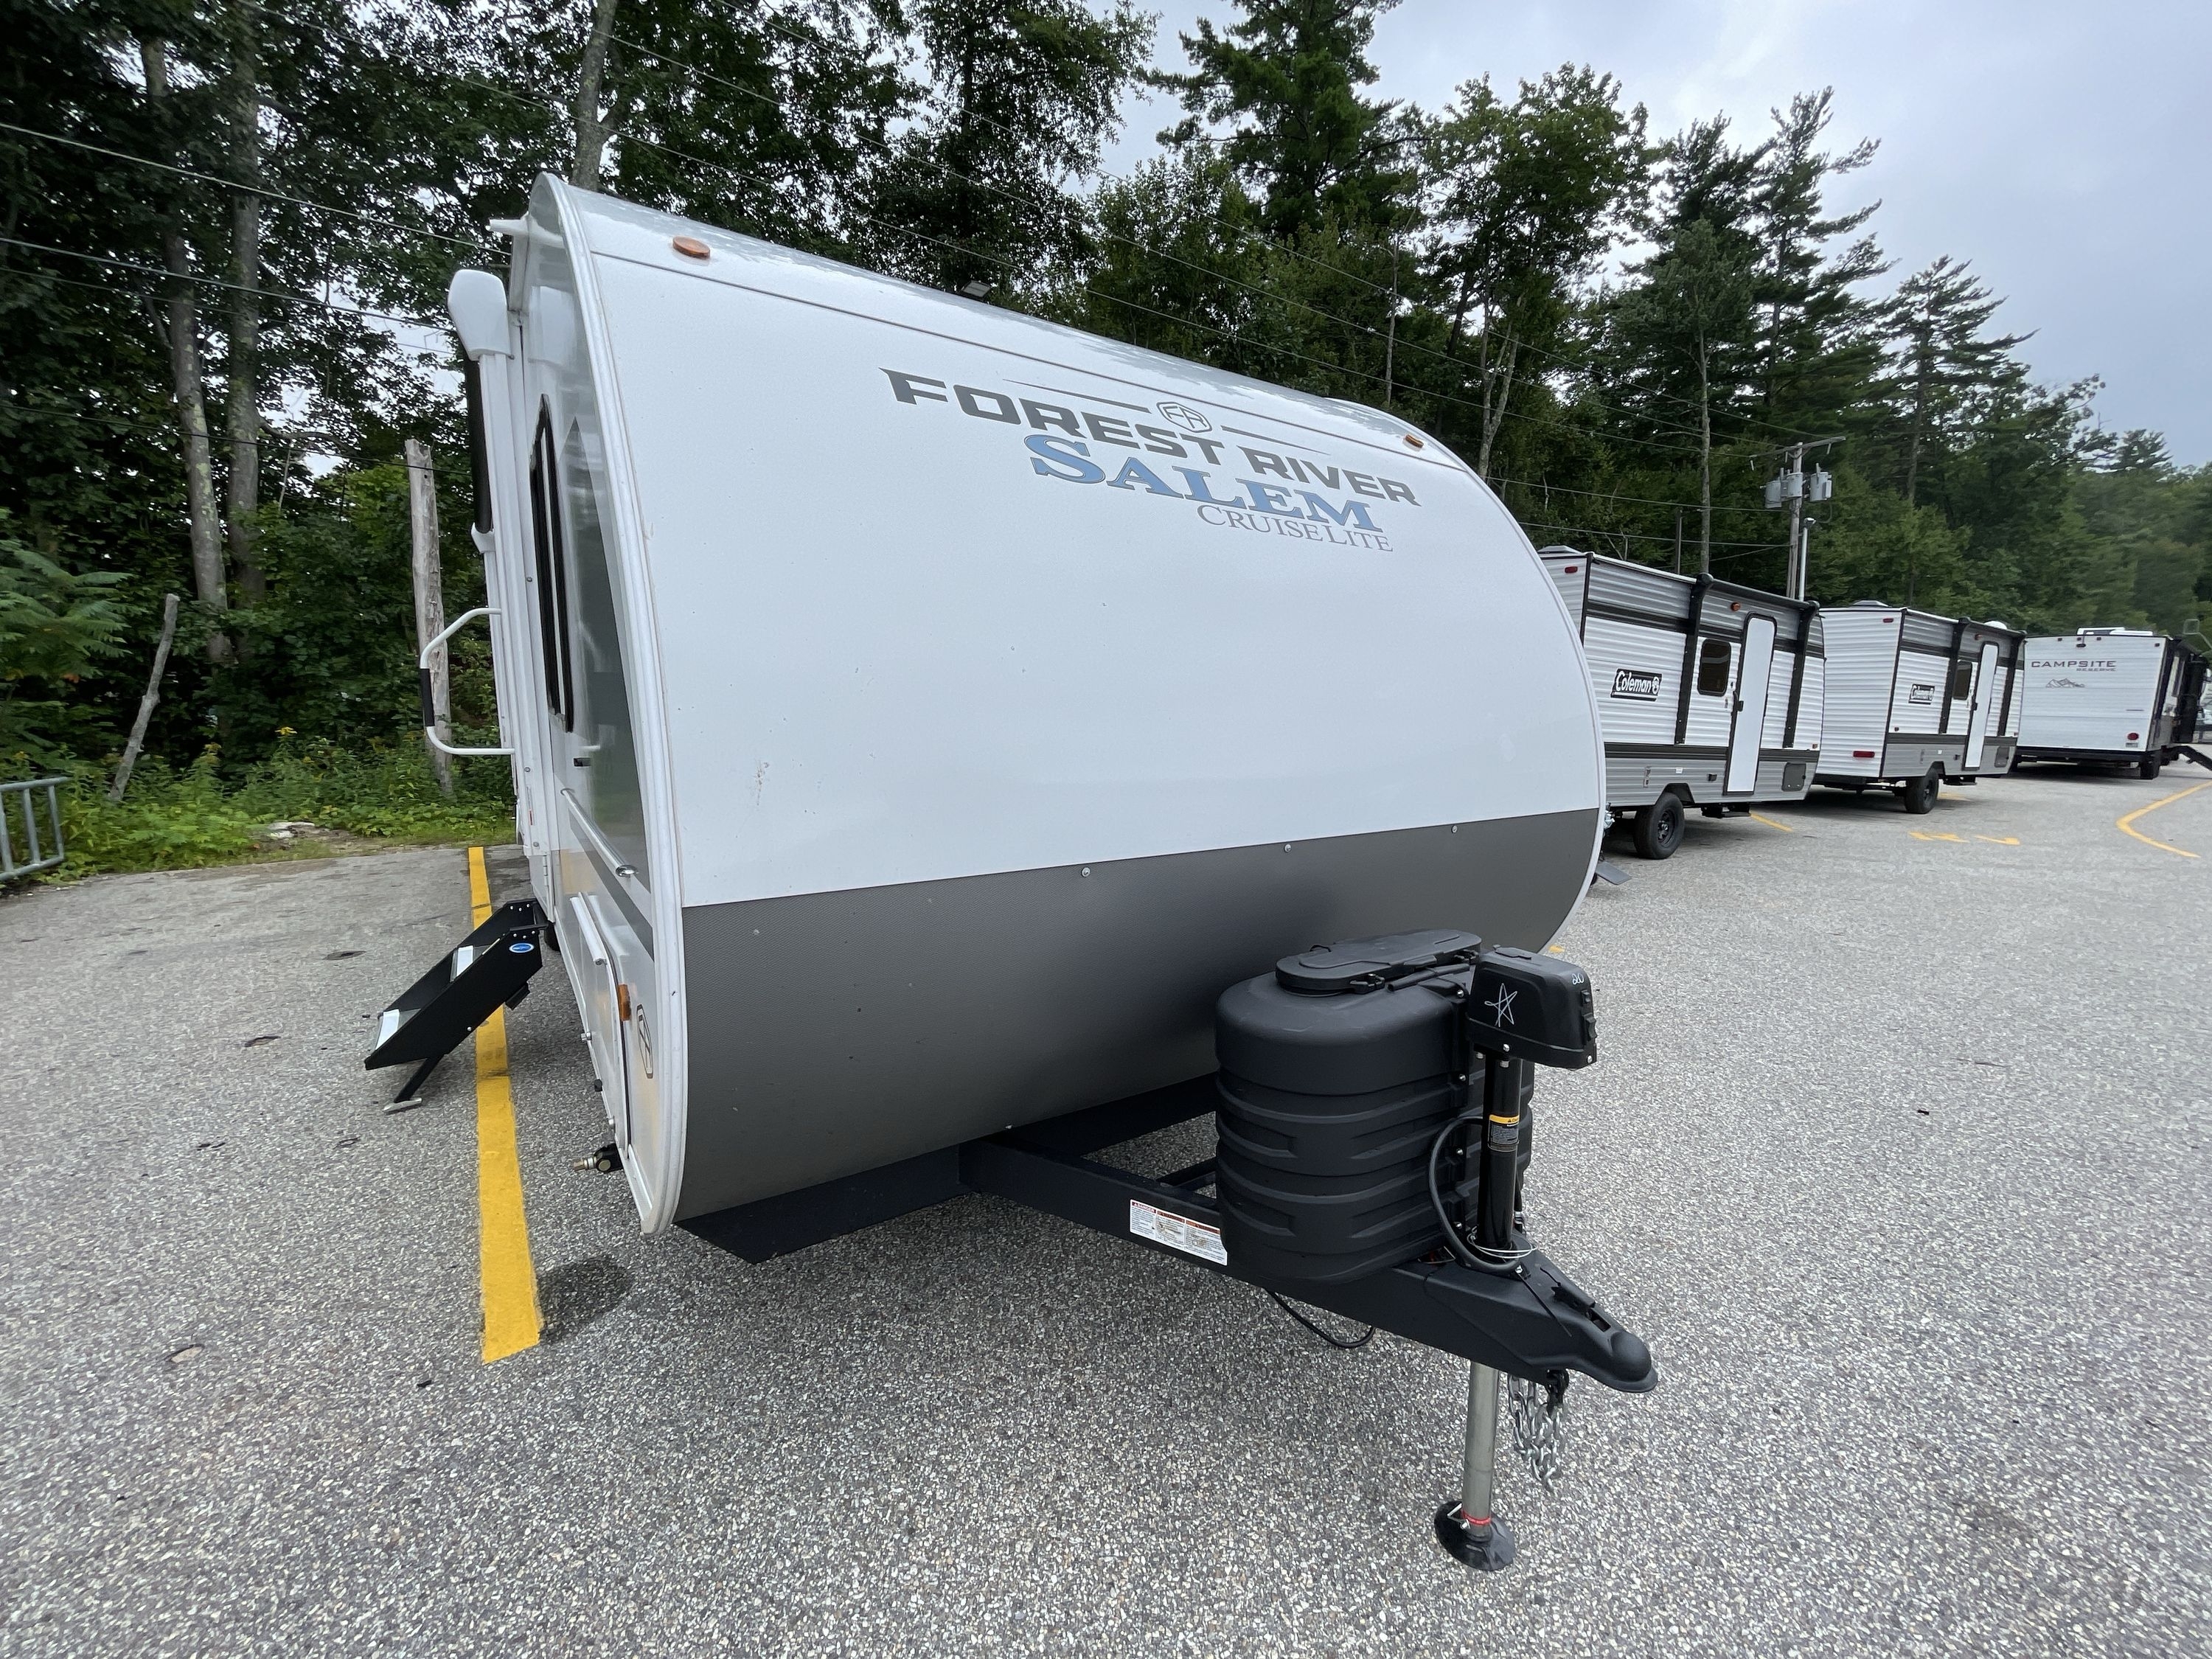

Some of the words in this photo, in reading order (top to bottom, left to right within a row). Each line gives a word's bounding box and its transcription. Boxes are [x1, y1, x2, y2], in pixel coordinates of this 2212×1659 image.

[878, 366, 1225, 465] FOREST
[1237, 445, 1422, 507] RIVER
[1023, 434, 1383, 533] SALEM
[1615, 670, 1652, 693] Coleman
